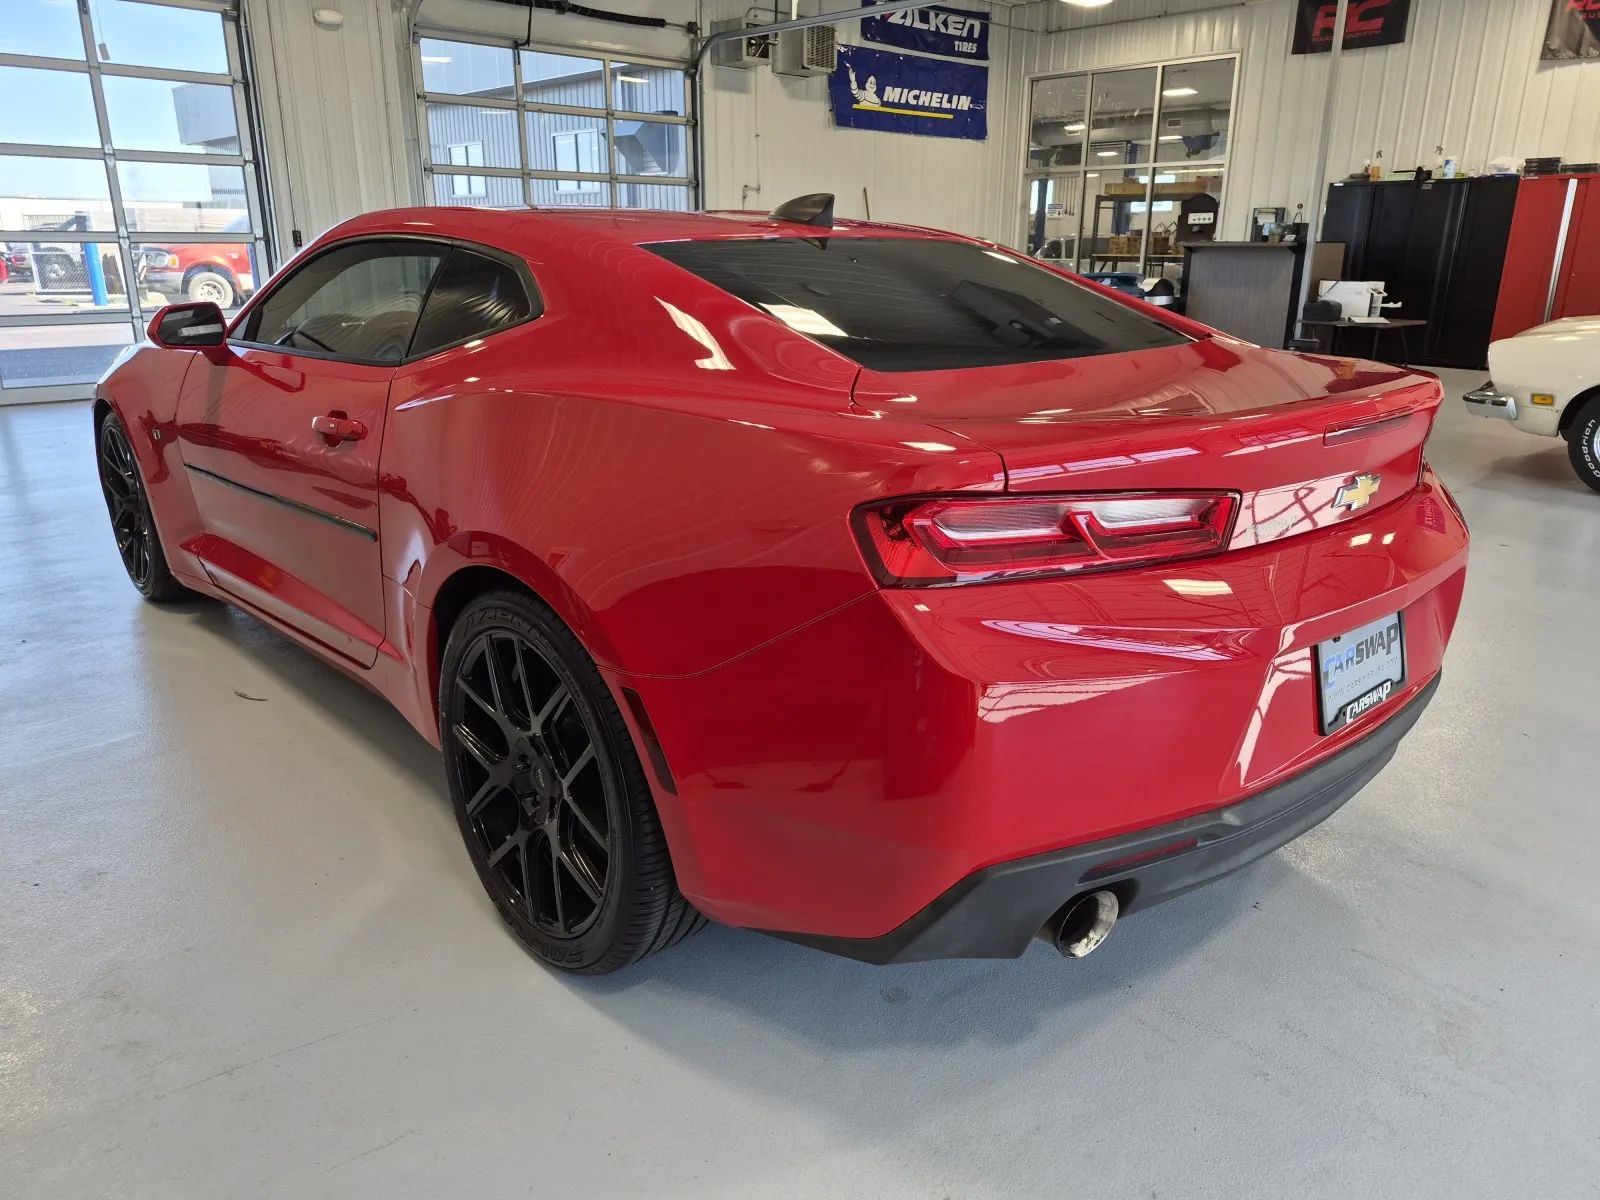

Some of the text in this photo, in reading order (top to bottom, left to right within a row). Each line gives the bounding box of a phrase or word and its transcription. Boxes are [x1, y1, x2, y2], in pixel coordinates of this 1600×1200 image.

[954, 41, 978, 54] TIRES
[883, 86, 972, 111] MICHELIN
[1323, 622, 1399, 691] CARSWAP
[1345, 681, 1391, 724] CARSWAP
